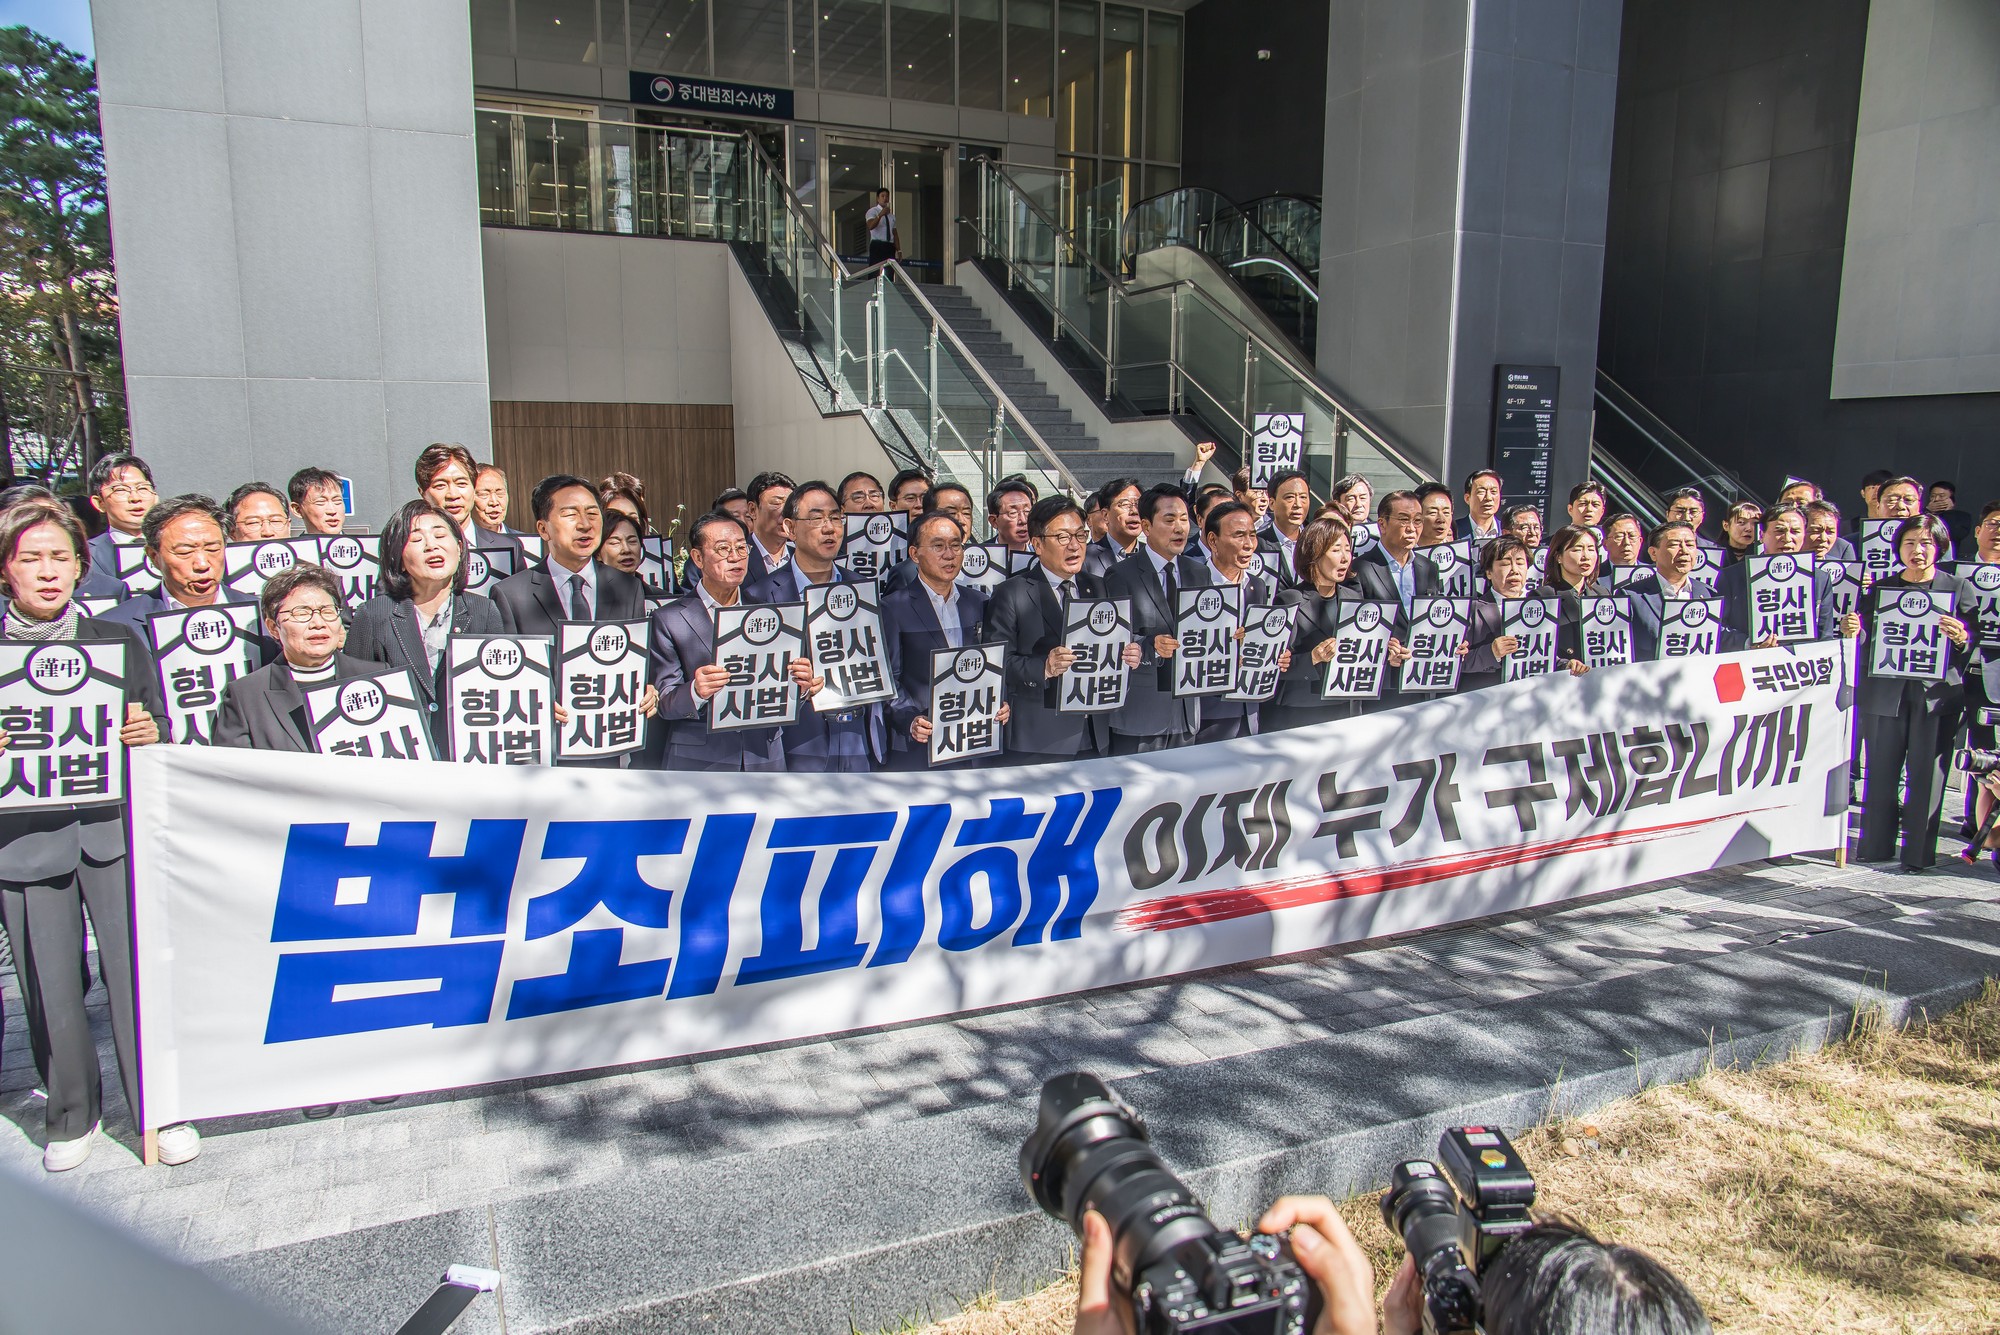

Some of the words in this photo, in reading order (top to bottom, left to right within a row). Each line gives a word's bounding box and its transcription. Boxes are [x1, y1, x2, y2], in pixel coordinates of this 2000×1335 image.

[678, 83, 776, 110] 중대범죄수사청
[1258, 442, 1297, 463] 형사
[869, 522, 890, 535] 謹弔
[258, 552, 291, 570] 謹弔
[332, 545, 358, 559] 謹弔
[963, 554, 985, 567] 謹弔
[1434, 551, 1452, 564] 謹弔
[469, 561, 484, 576] 弔
[1772, 562, 1793, 574] 謹弔
[830, 593, 854, 610] 謹弔
[1200, 597, 1220, 611] 謹弔
[1597, 605, 1613, 616] 謹弔
[1756, 585, 1807, 613] 형사
[1902, 597, 1927, 610] 謹弔
[748, 617, 776, 634] 謹弔
[1092, 610, 1114, 625] 謹弔
[1266, 615, 1285, 628] 謹弔
[1358, 610, 1378, 623] 謹弔
[1431, 606, 1451, 619] 謹弔
[1524, 606, 1542, 619] 謹弔
[1684, 608, 1705, 619] 謹弔
[1757, 611, 1808, 638] 사법
[189, 620, 227, 641] 謹弔
[595, 635, 624, 652] 謹弔
[1182, 626, 1232, 658] 형사
[1586, 630, 1627, 656] 형사
[1882, 621, 1942, 648] 형사
[485, 649, 518, 665] 謹弔
[816, 625, 877, 664] 형사
[1242, 640, 1286, 668] 형사
[1336, 637, 1384, 665] 형사
[1411, 633, 1458, 659] 형사
[1511, 632, 1552, 660] 형사
[1665, 632, 1714, 657] 형사
[35, 658, 81, 678] 謹弔
[723, 650, 794, 687] 형사
[958, 657, 982, 673] 謹弔
[1180, 658, 1231, 690] 사법
[1406, 661, 1454, 686] 사법
[1879, 648, 1937, 674] 사법
[824, 660, 884, 697] 사법
[1238, 668, 1278, 696] 사법
[1330, 666, 1377, 693] 사법
[1752, 657, 1833, 693] 국민의힘
[344, 689, 380, 713] 謹弔
[570, 670, 640, 710] 형사
[1066, 674, 1122, 706] 사법
[461, 689, 543, 727] 형사
[719, 686, 789, 721] 사법
[939, 686, 996, 723] 형사
[0, 704, 112, 751] 형사
[569, 708, 637, 748] 사법
[937, 718, 993, 755] 사법
[463, 730, 541, 765] 사법
[0, 752, 109, 798] 사법
[264, 787, 1122, 1044] 범죄피해
[1124, 779, 1293, 890] 이제
[1313, 752, 1462, 859] 누가
[1482, 703, 1813, 833] 구제합니까!
